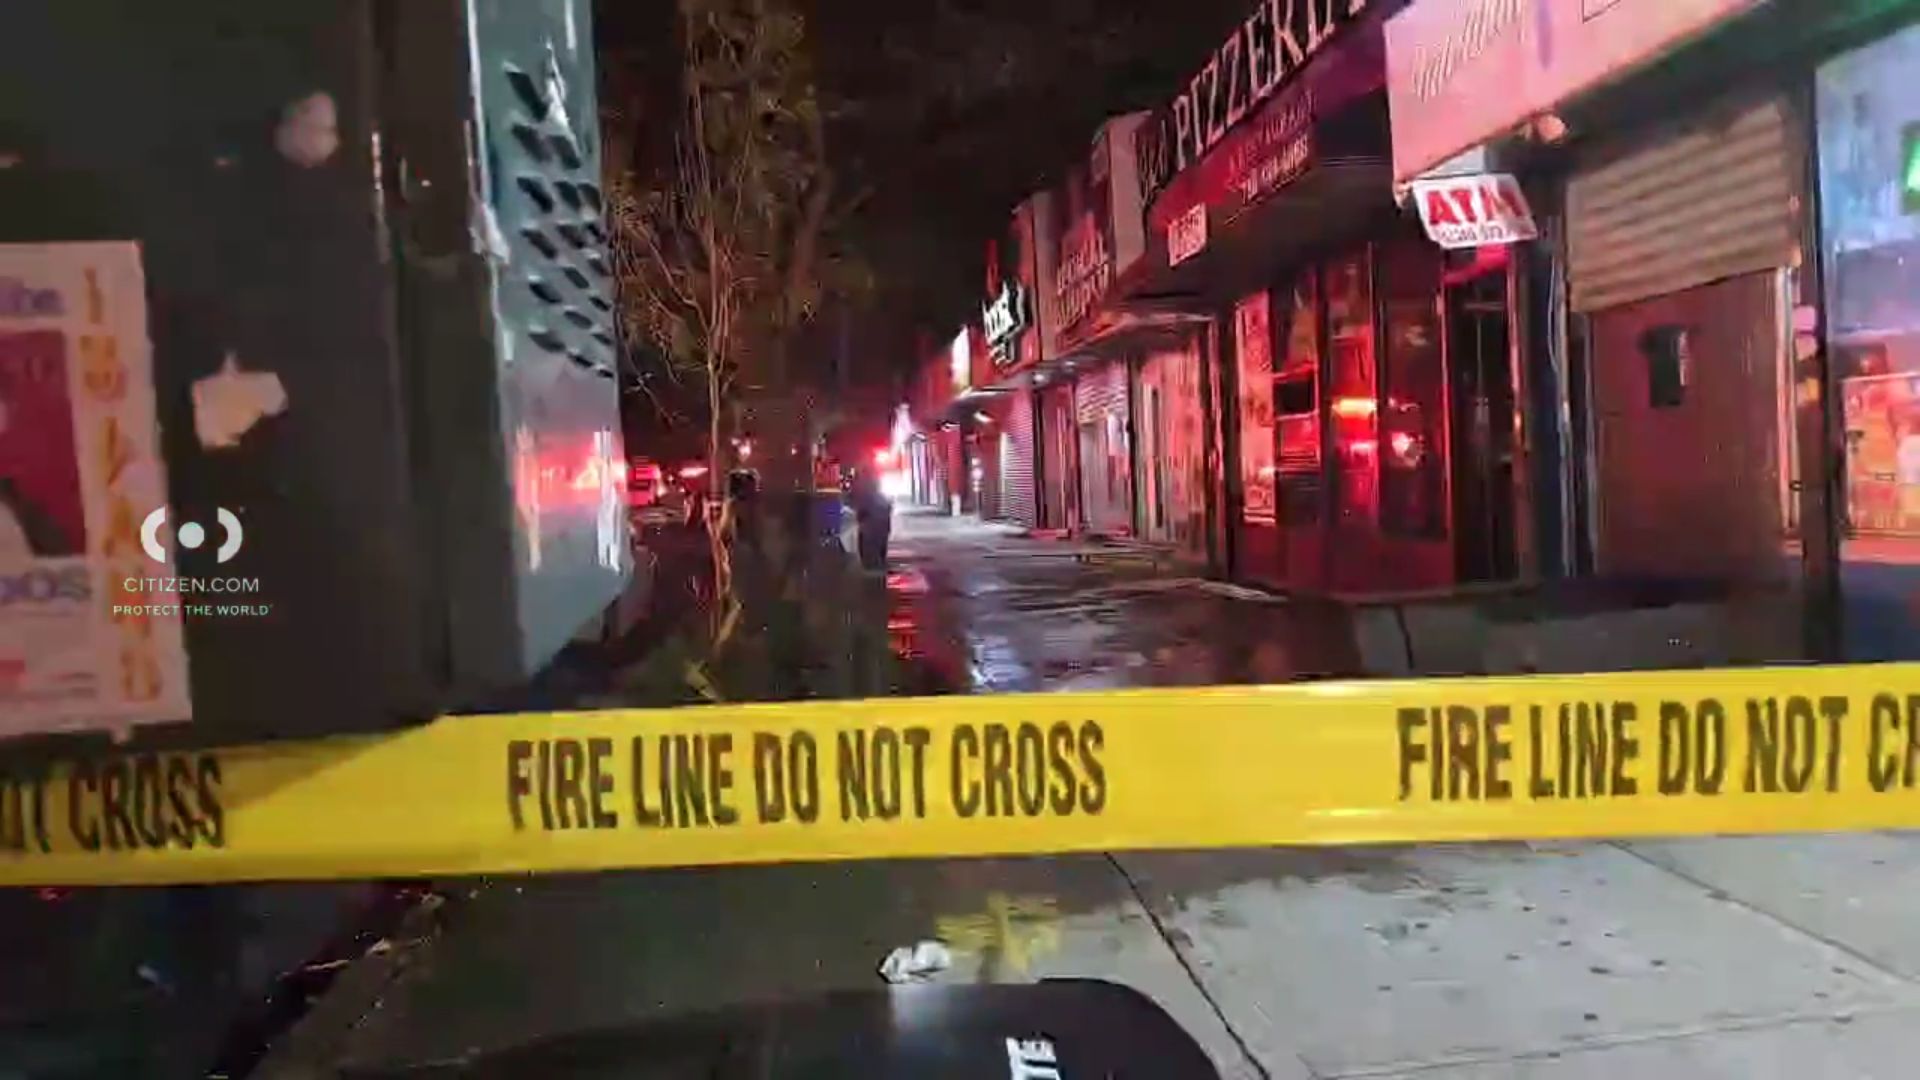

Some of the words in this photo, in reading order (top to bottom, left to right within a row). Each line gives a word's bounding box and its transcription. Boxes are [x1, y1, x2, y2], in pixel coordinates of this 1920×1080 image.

[1172, 0, 1366, 172] PIZZERI
[1426, 183, 1525, 226] ATM
[505, 736, 618, 832] FIRE
[632, 732, 739, 830] LINE
[754, 730, 820, 824] DO
[837, 725, 932, 821] NOT
[949, 719, 1107, 818] CROSS
[1396, 704, 1513, 802] FIRE
[1529, 701, 1639, 800] LINE
[1657, 699, 1728, 796] DO
[1743, 696, 1850, 793] NOT
[68, 752, 225, 854] CROSS
